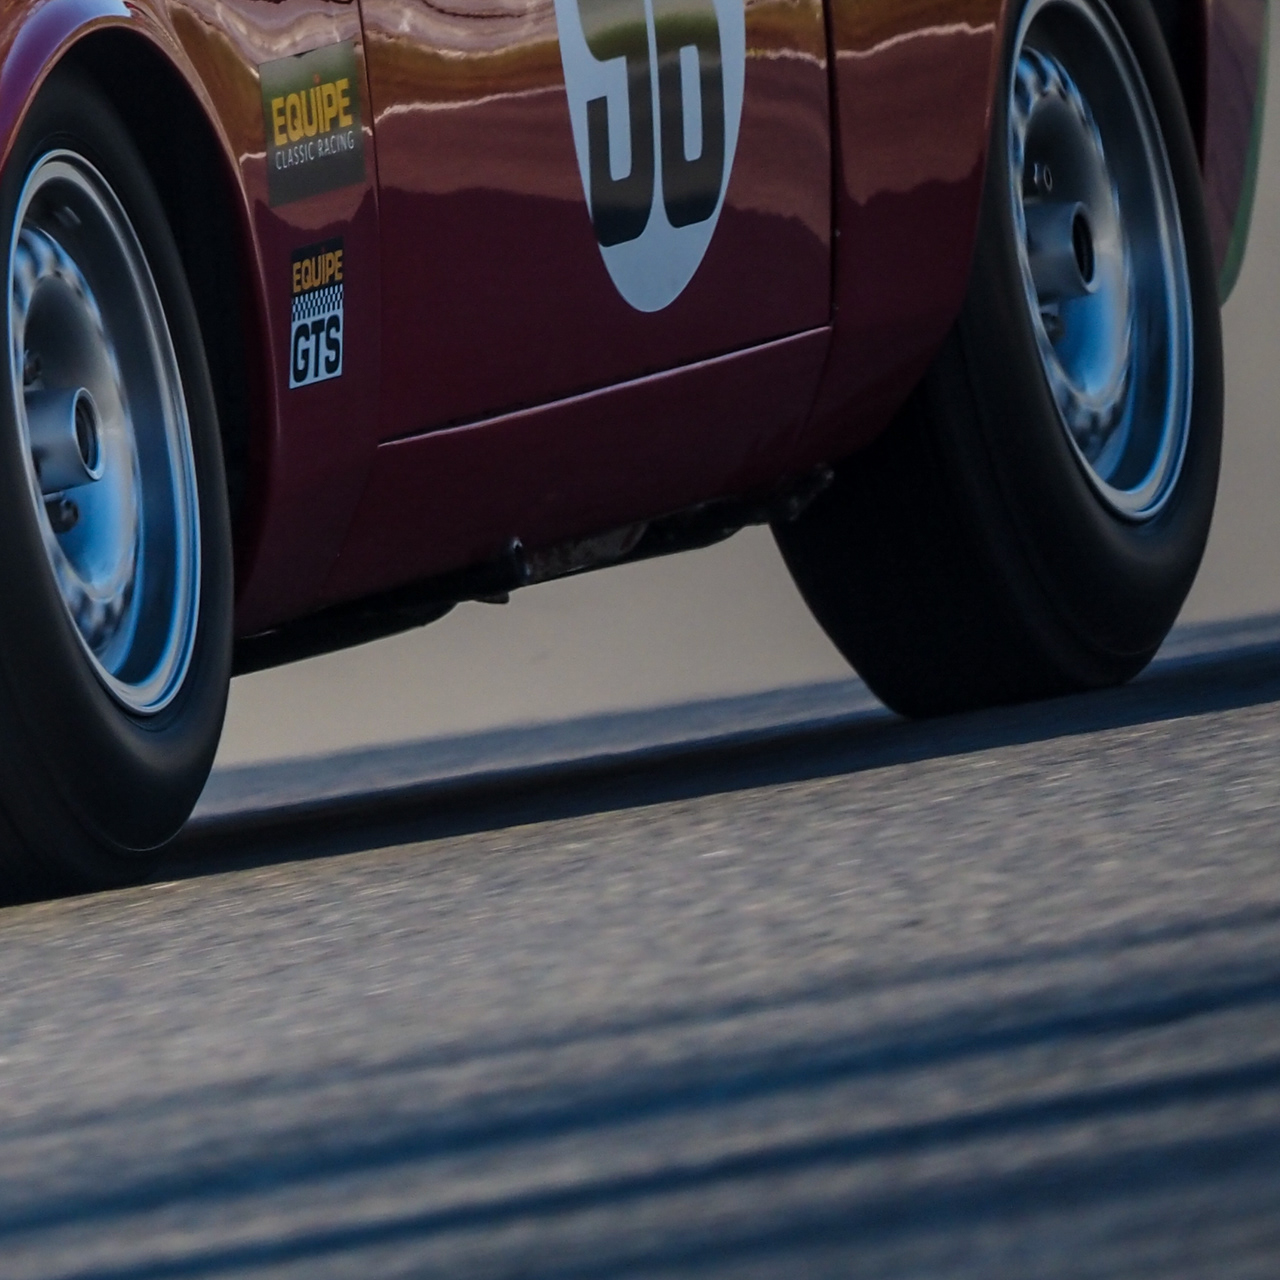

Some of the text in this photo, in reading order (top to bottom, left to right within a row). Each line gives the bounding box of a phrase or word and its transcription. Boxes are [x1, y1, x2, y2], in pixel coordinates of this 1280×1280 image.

[271, 74, 354, 147] EQUIPE
[274, 129, 355, 171] CLASSIC RACING
[292, 248, 344, 294] EQUIPE
[292, 313, 341, 385] GTS
